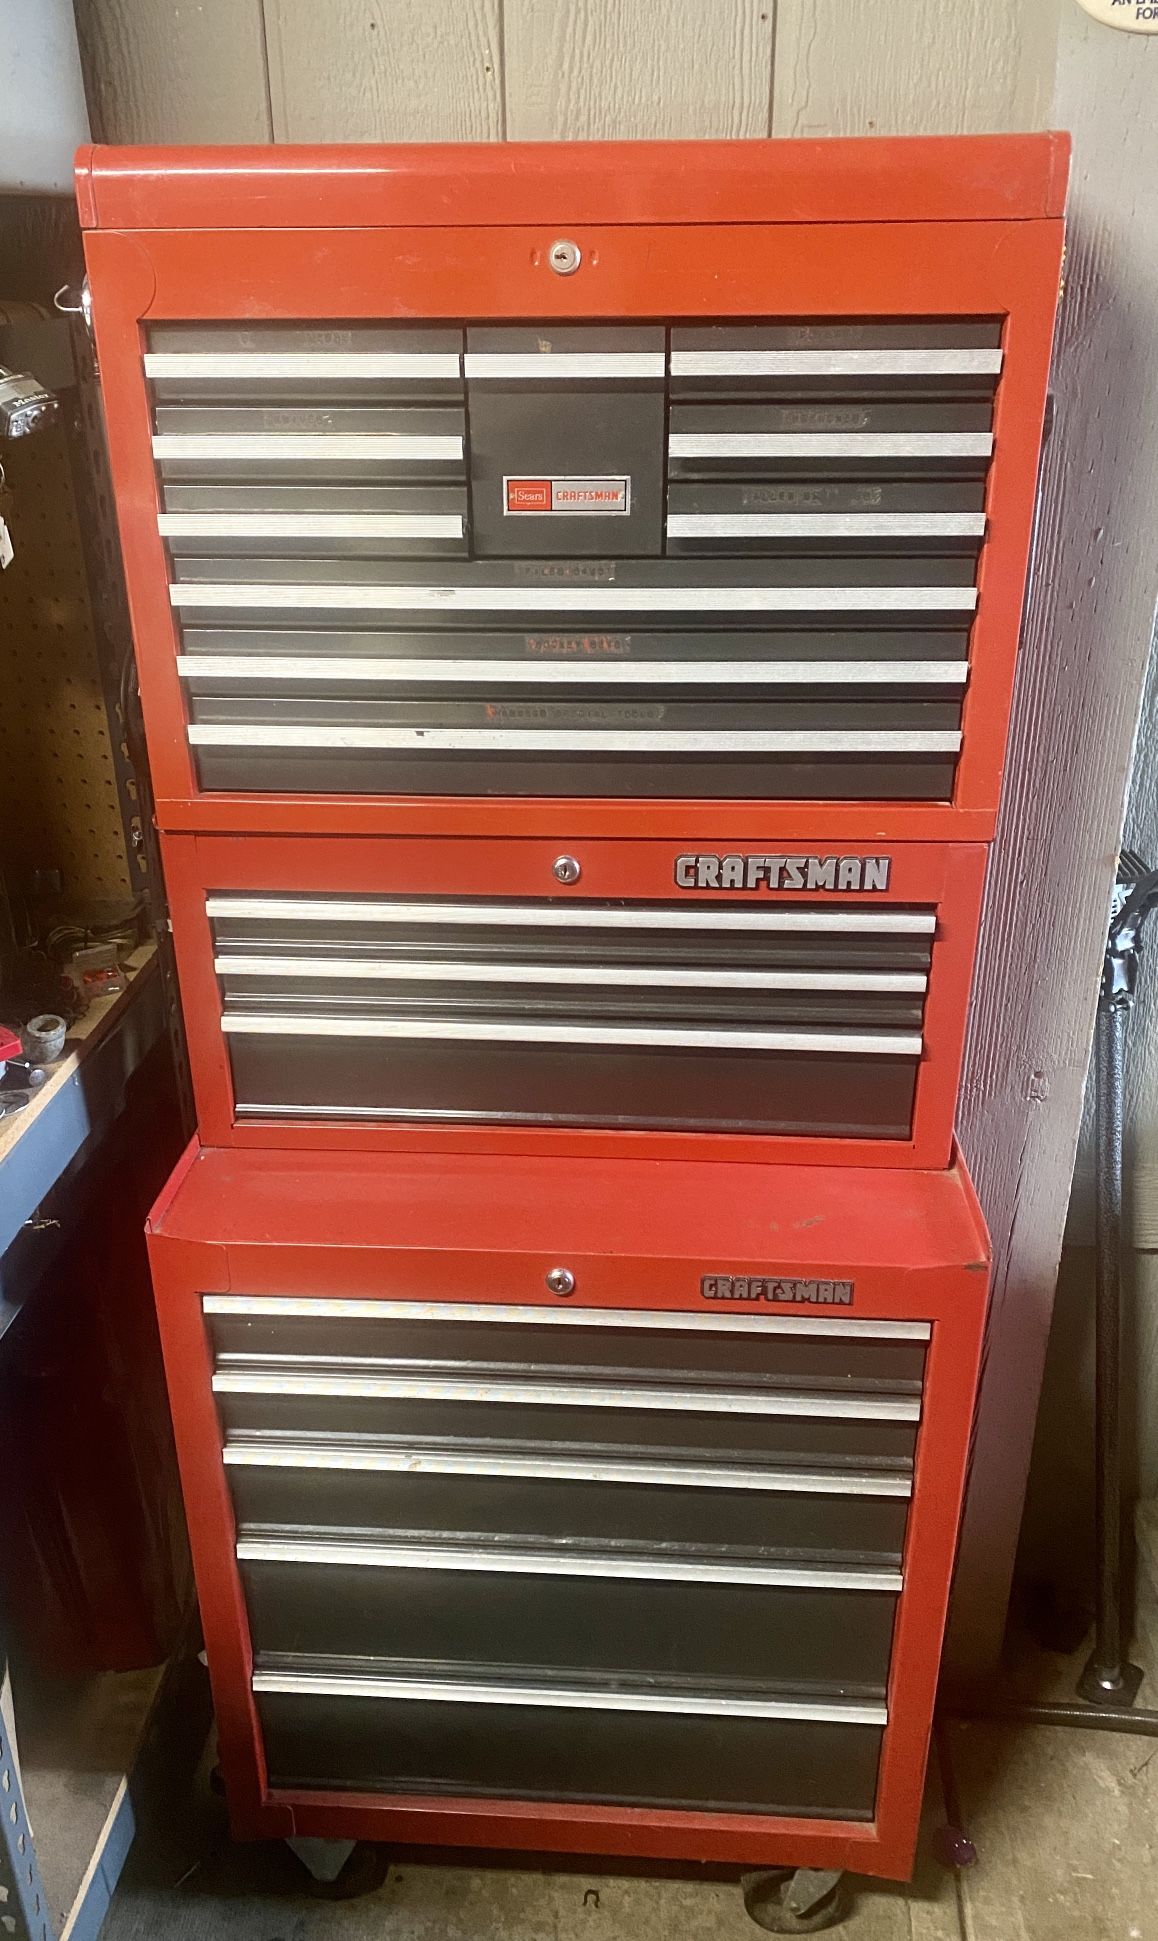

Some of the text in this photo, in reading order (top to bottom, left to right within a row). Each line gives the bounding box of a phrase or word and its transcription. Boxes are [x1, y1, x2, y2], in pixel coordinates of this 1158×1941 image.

[12, 393, 49, 407] Master
[517, 490, 620, 502] Sears CRAFTSMAN
[675, 855, 891, 893] CRAFTSMAN
[702, 1275, 854, 1305] CRAFTSMAN
